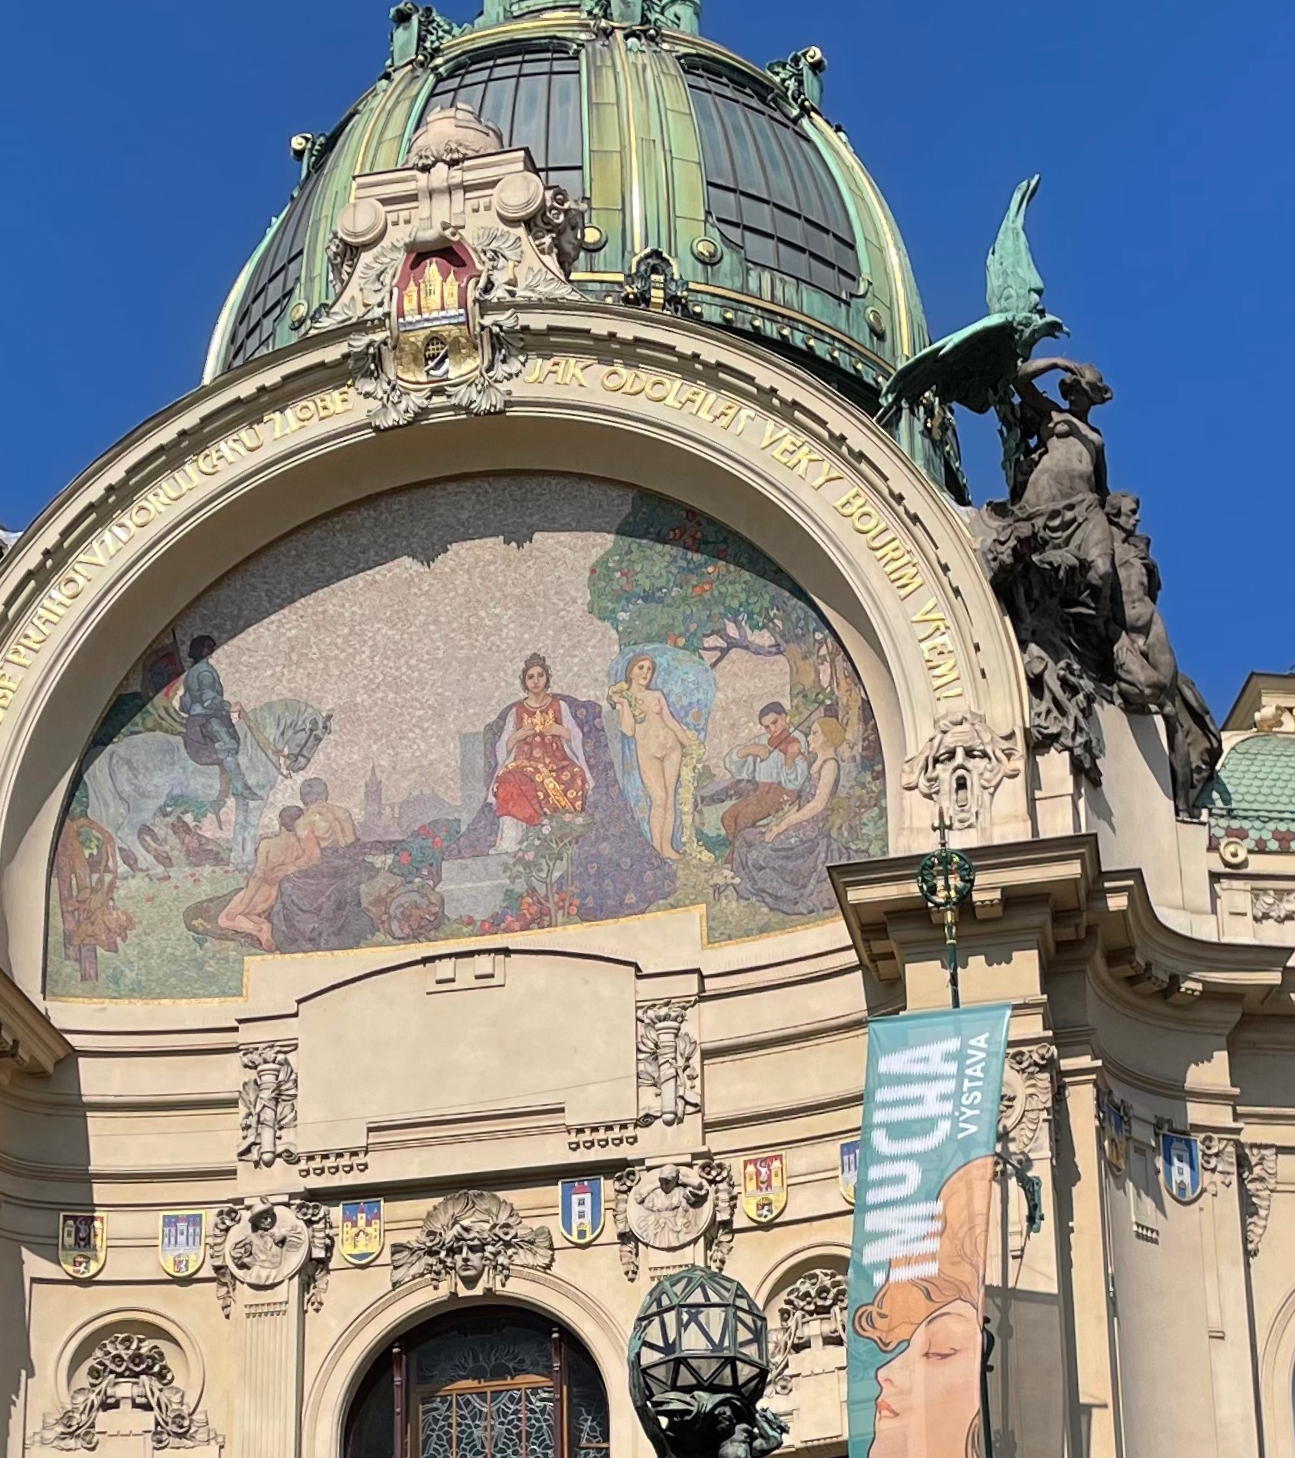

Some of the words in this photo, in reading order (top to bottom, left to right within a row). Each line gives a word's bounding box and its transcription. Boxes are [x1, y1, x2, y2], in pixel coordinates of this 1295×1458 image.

[523, 357, 593, 388] JAK
[759, 417, 844, 491] VĚKY
[957, 1032, 990, 1140] VÝSTAVA
